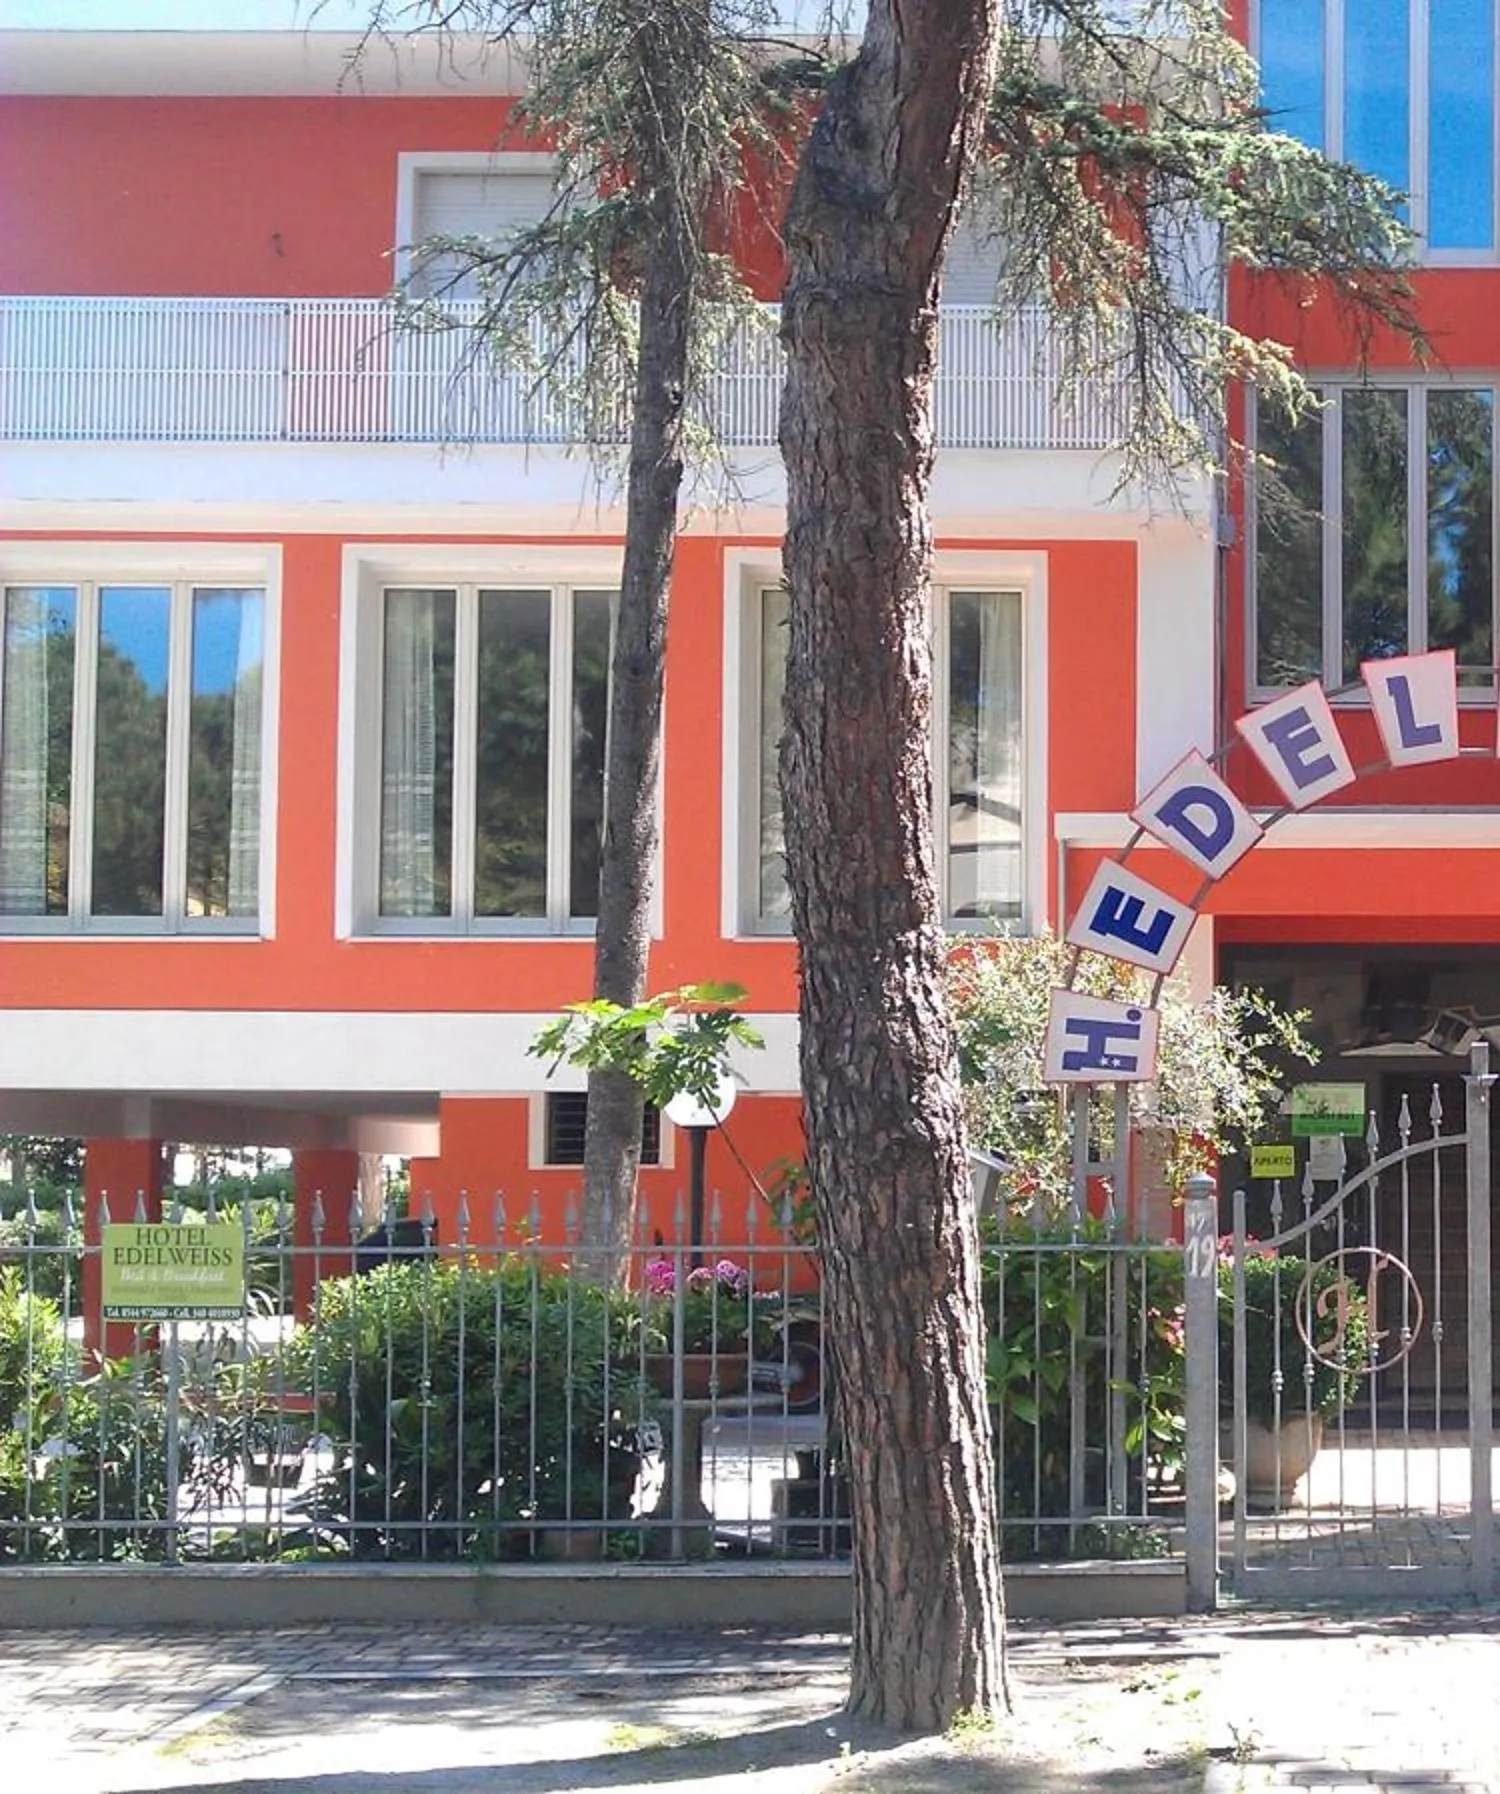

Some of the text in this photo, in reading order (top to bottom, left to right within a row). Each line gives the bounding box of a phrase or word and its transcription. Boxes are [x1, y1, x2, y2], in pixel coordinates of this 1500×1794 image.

[136, 1227, 212, 1246] HOTEL
[113, 1247, 233, 1266] EDELWEISS
[1186, 1235, 1216, 1278] 19
[120, 1267, 144, 1282] Bed
[162, 1266, 225, 1288] Breakfast
